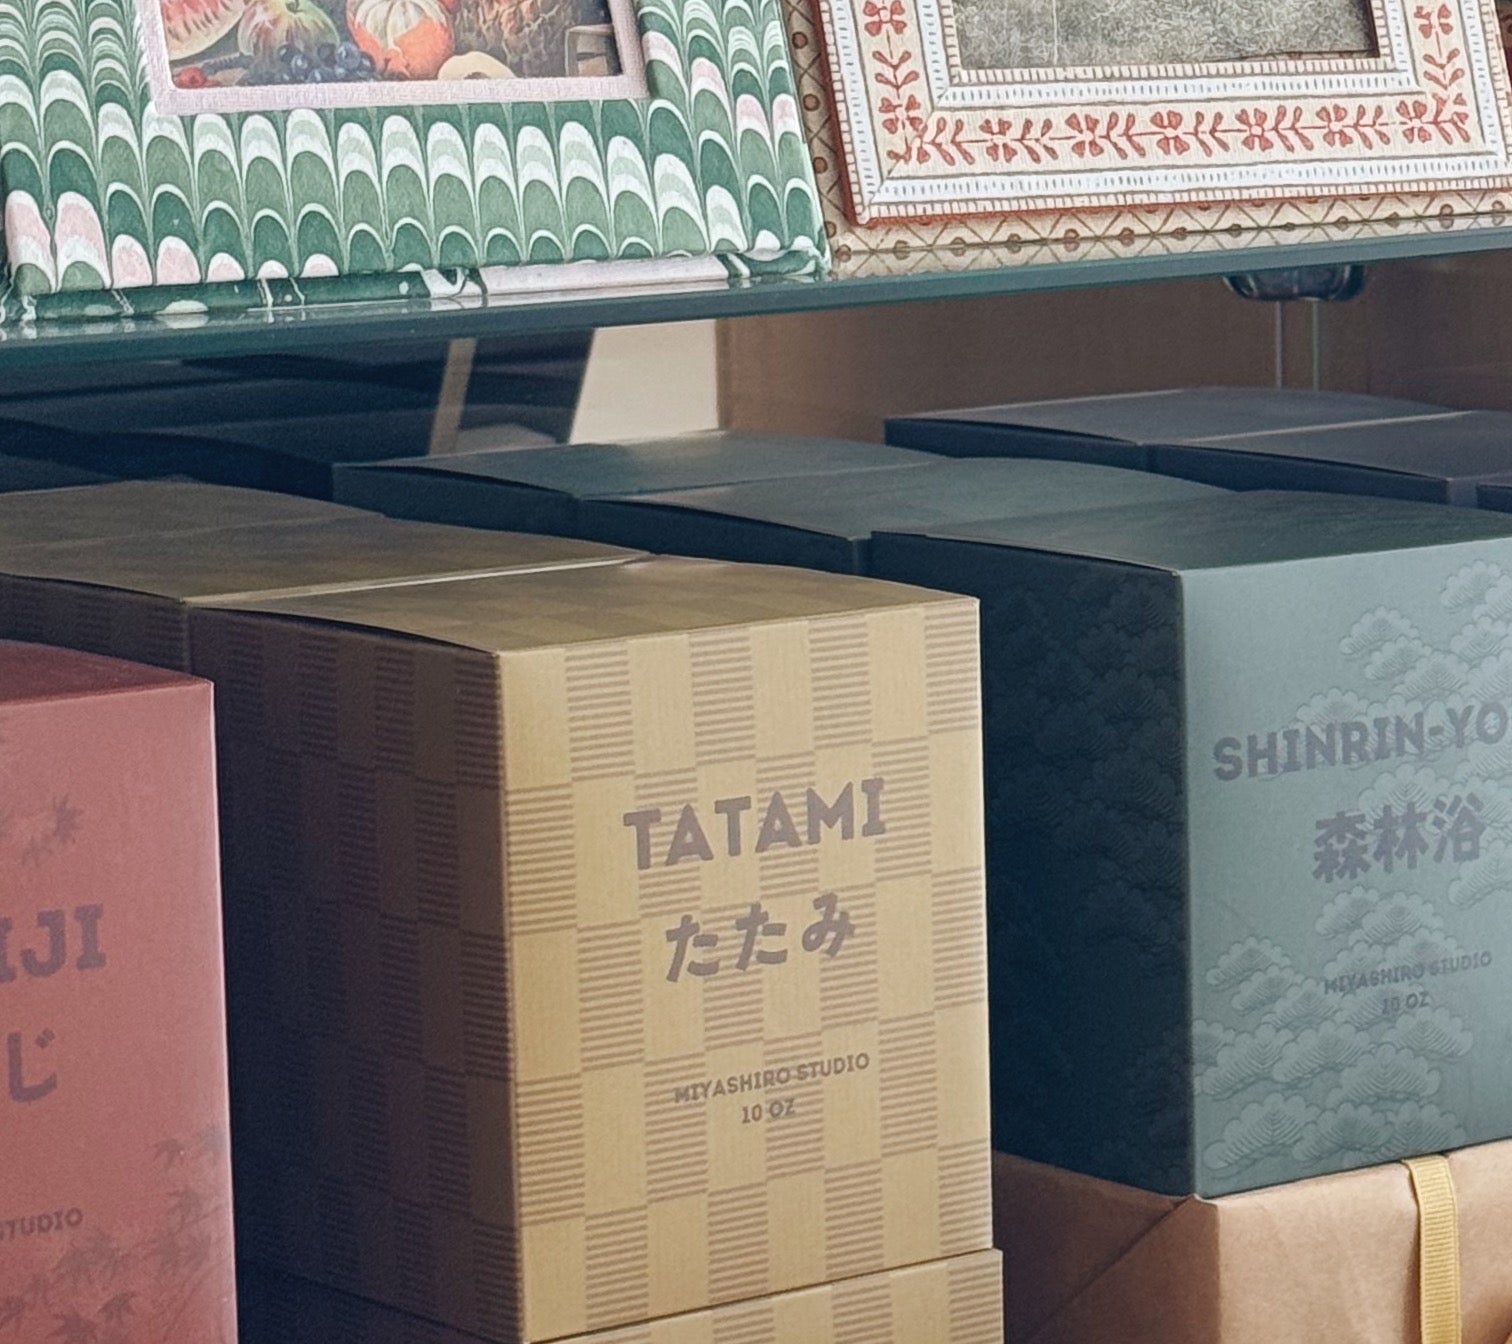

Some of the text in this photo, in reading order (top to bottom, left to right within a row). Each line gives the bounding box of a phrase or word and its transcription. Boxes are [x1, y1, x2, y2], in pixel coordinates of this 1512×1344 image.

[623, 777, 887, 871] TATAMI
[1312, 792, 1487, 883] 森林浴
[665, 892, 857, 983] たたみ
[1323, 949, 1493, 994] MIYASHIRO STUDIO
[1405, 990, 1431, 1010] OZ
[674, 1052, 870, 1103] MIYASHIRO STUDIO
[741, 1097, 797, 1124] 10 OZ
